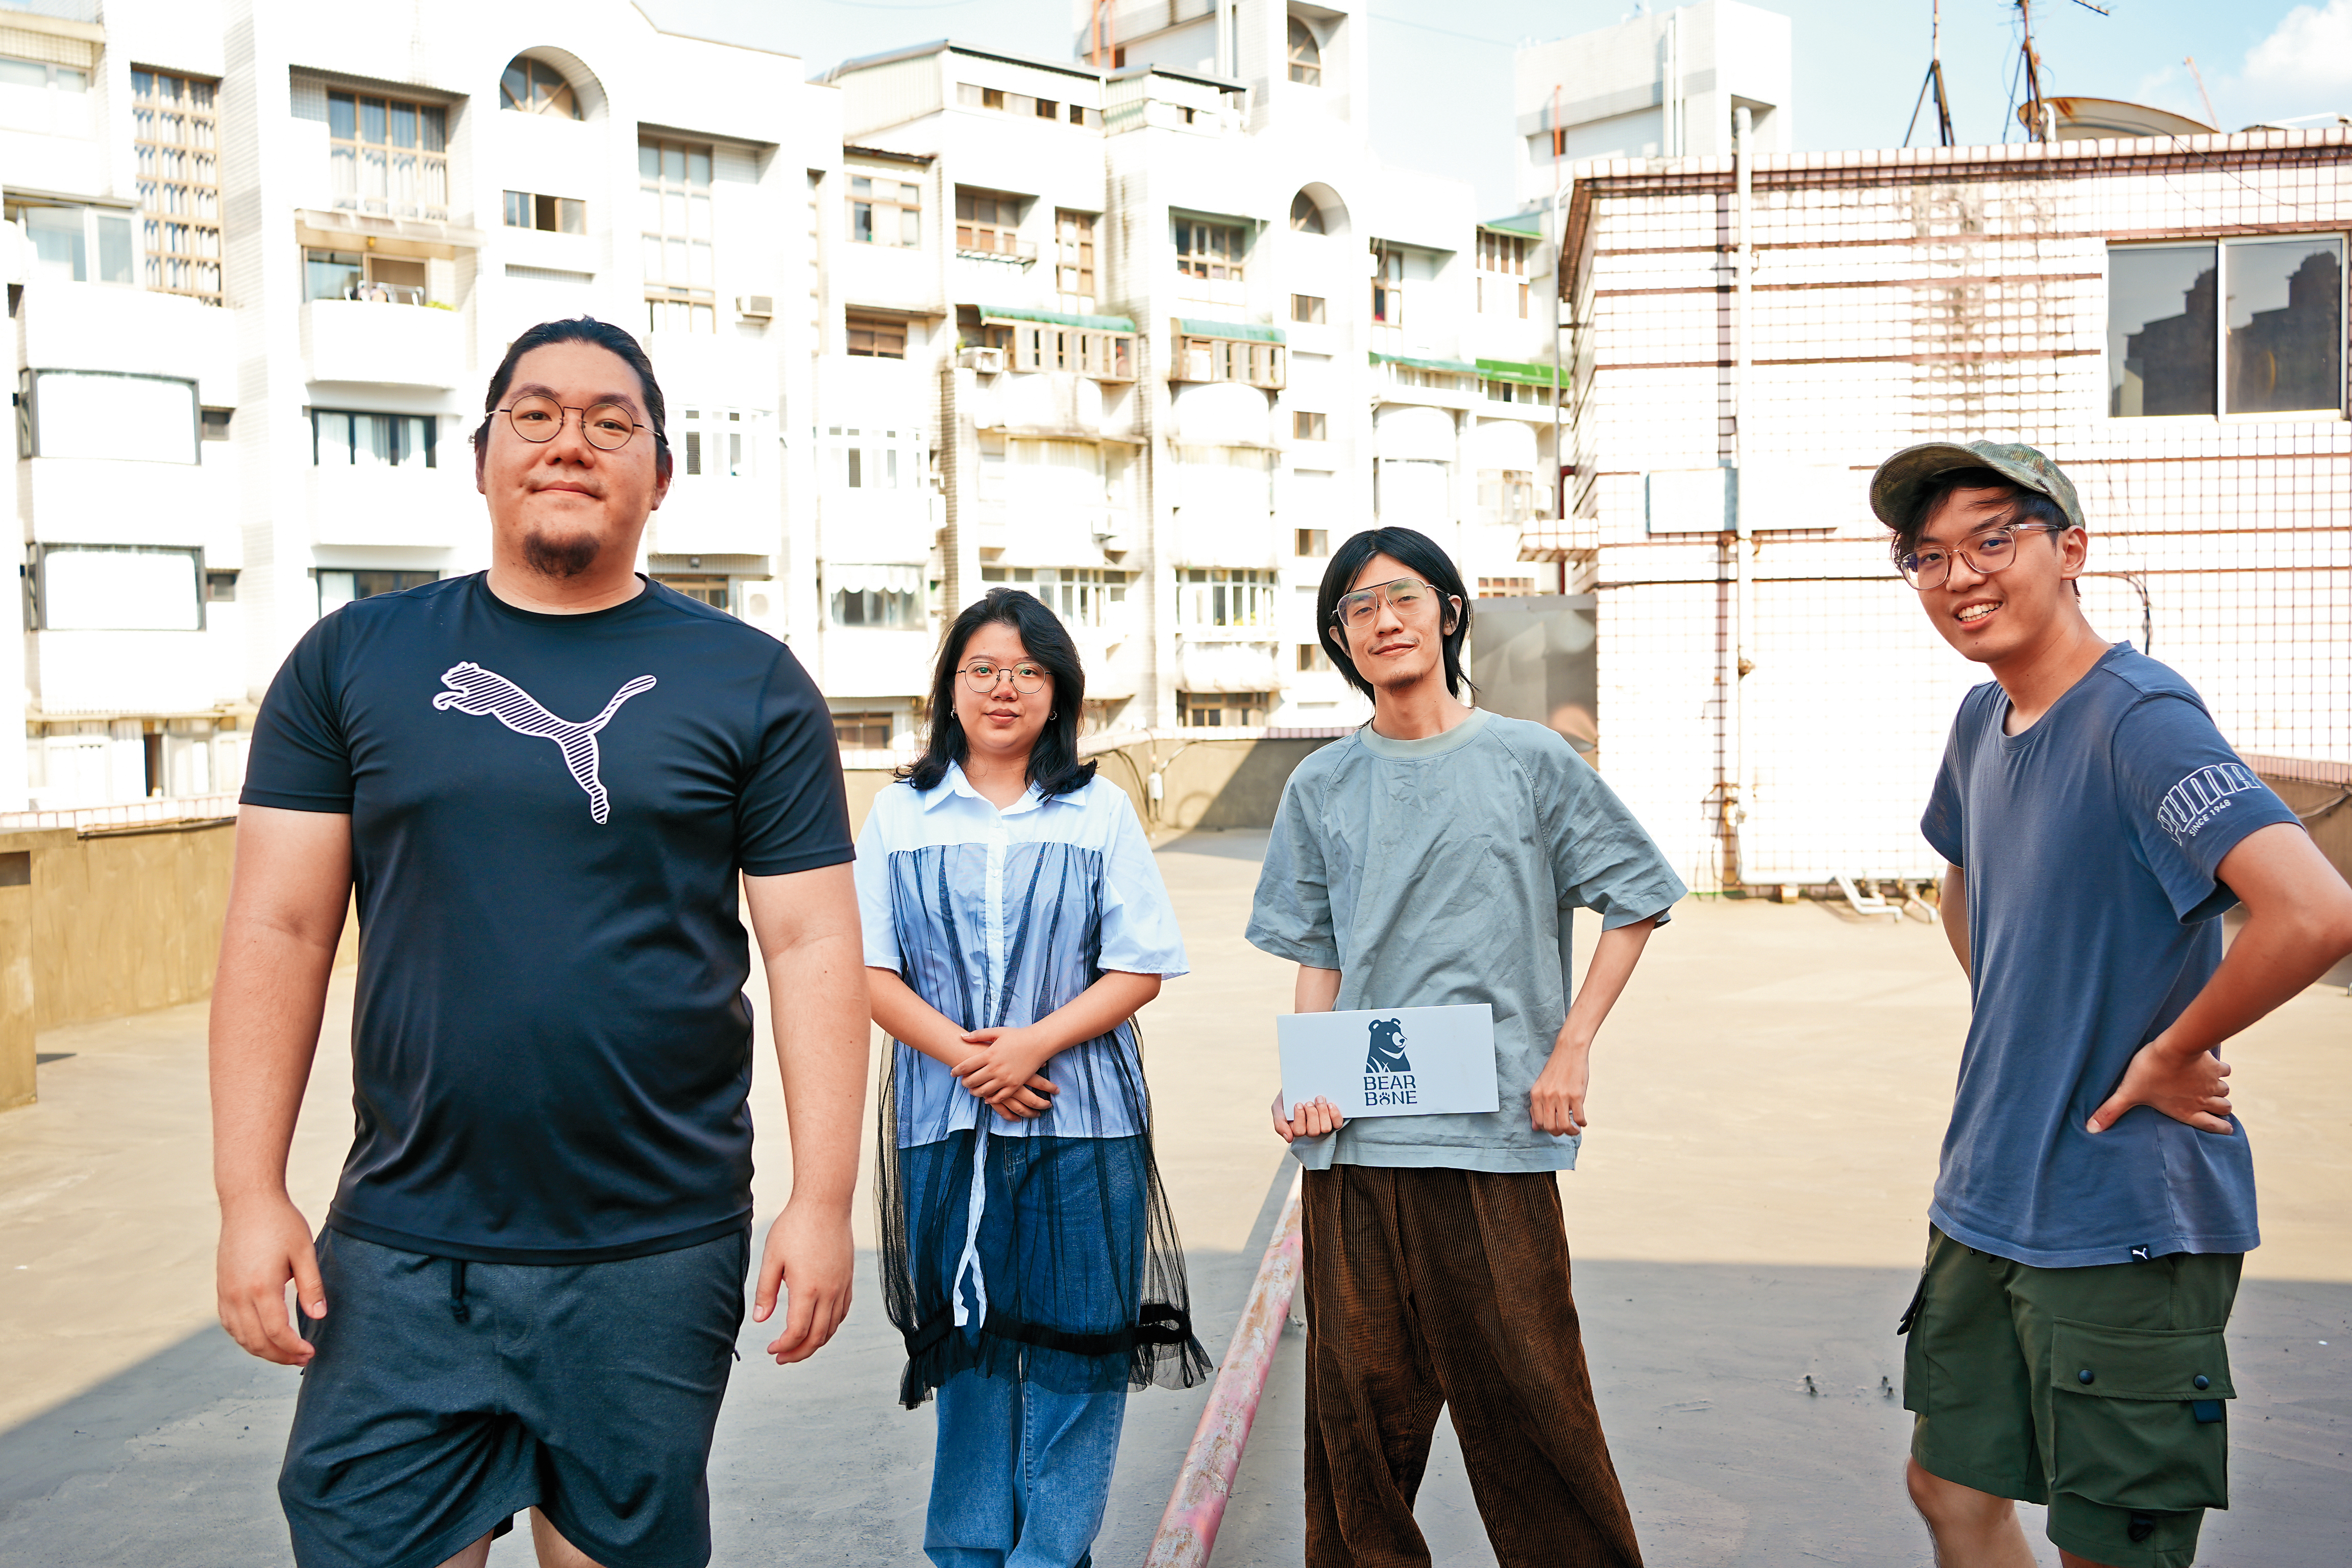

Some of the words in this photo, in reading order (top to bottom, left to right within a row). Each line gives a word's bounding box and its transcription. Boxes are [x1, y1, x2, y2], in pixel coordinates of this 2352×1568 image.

[2189, 814, 2210, 837] SINCE
[2210, 799, 2231, 816] 1948
[1363, 1075, 1416, 1090] BEAR
[1364, 1091, 1417, 1106] BONE
